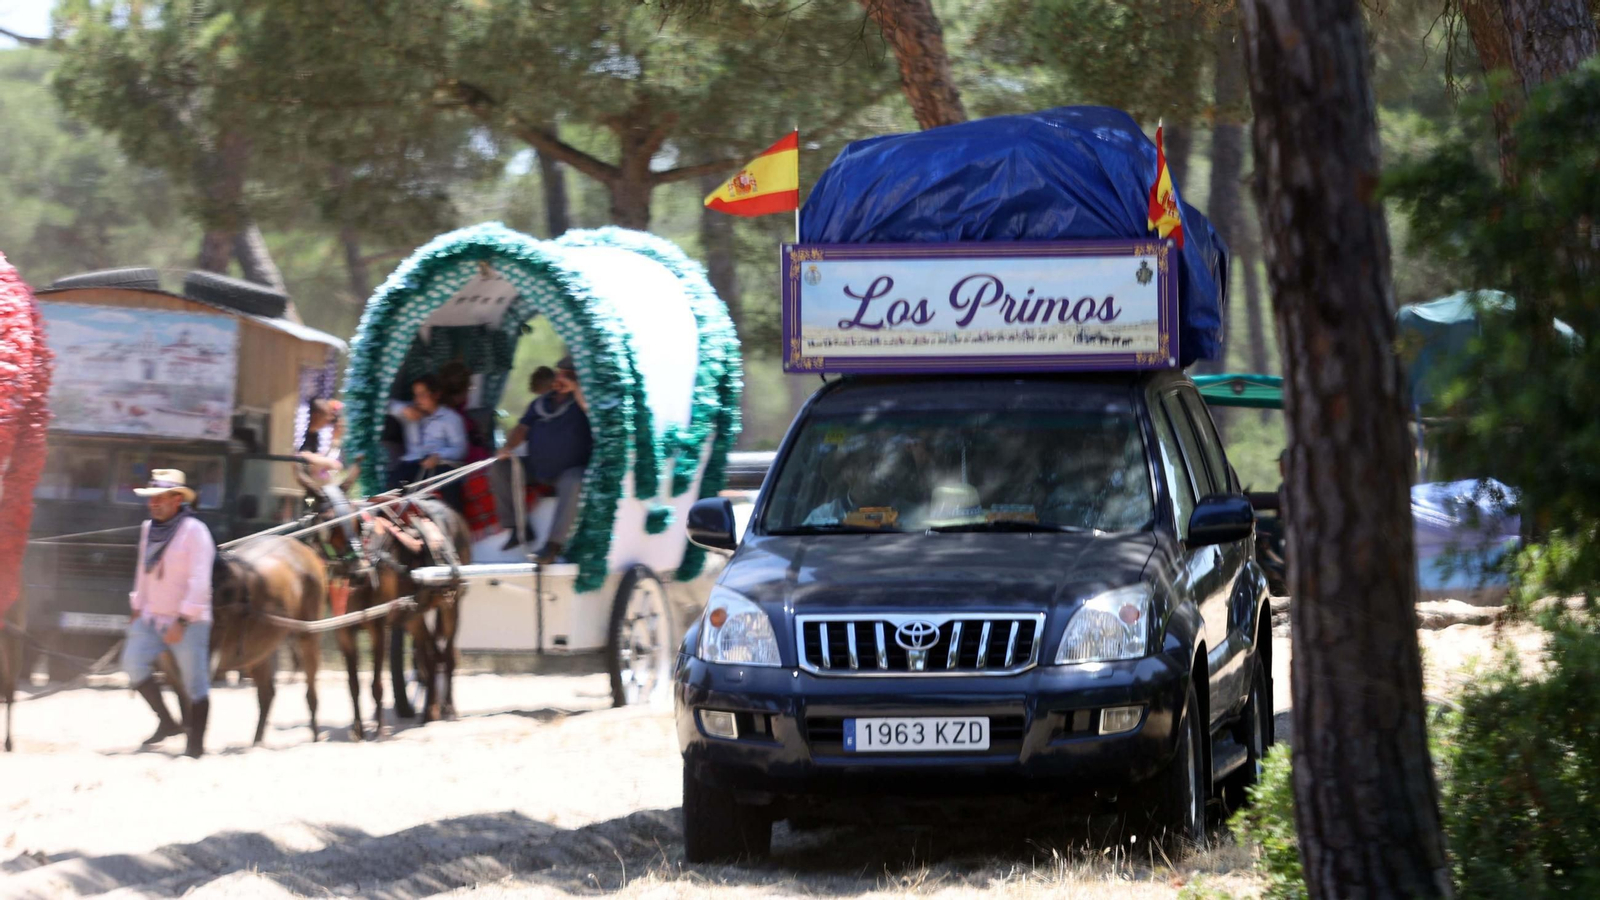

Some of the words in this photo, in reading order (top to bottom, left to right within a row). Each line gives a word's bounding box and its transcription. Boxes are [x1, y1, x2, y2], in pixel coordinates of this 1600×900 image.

[838, 275, 935, 330] Los
[948, 273, 1122, 327] Primos
[865, 722, 925, 746] 1963
[935, 721, 983, 744] KZD
